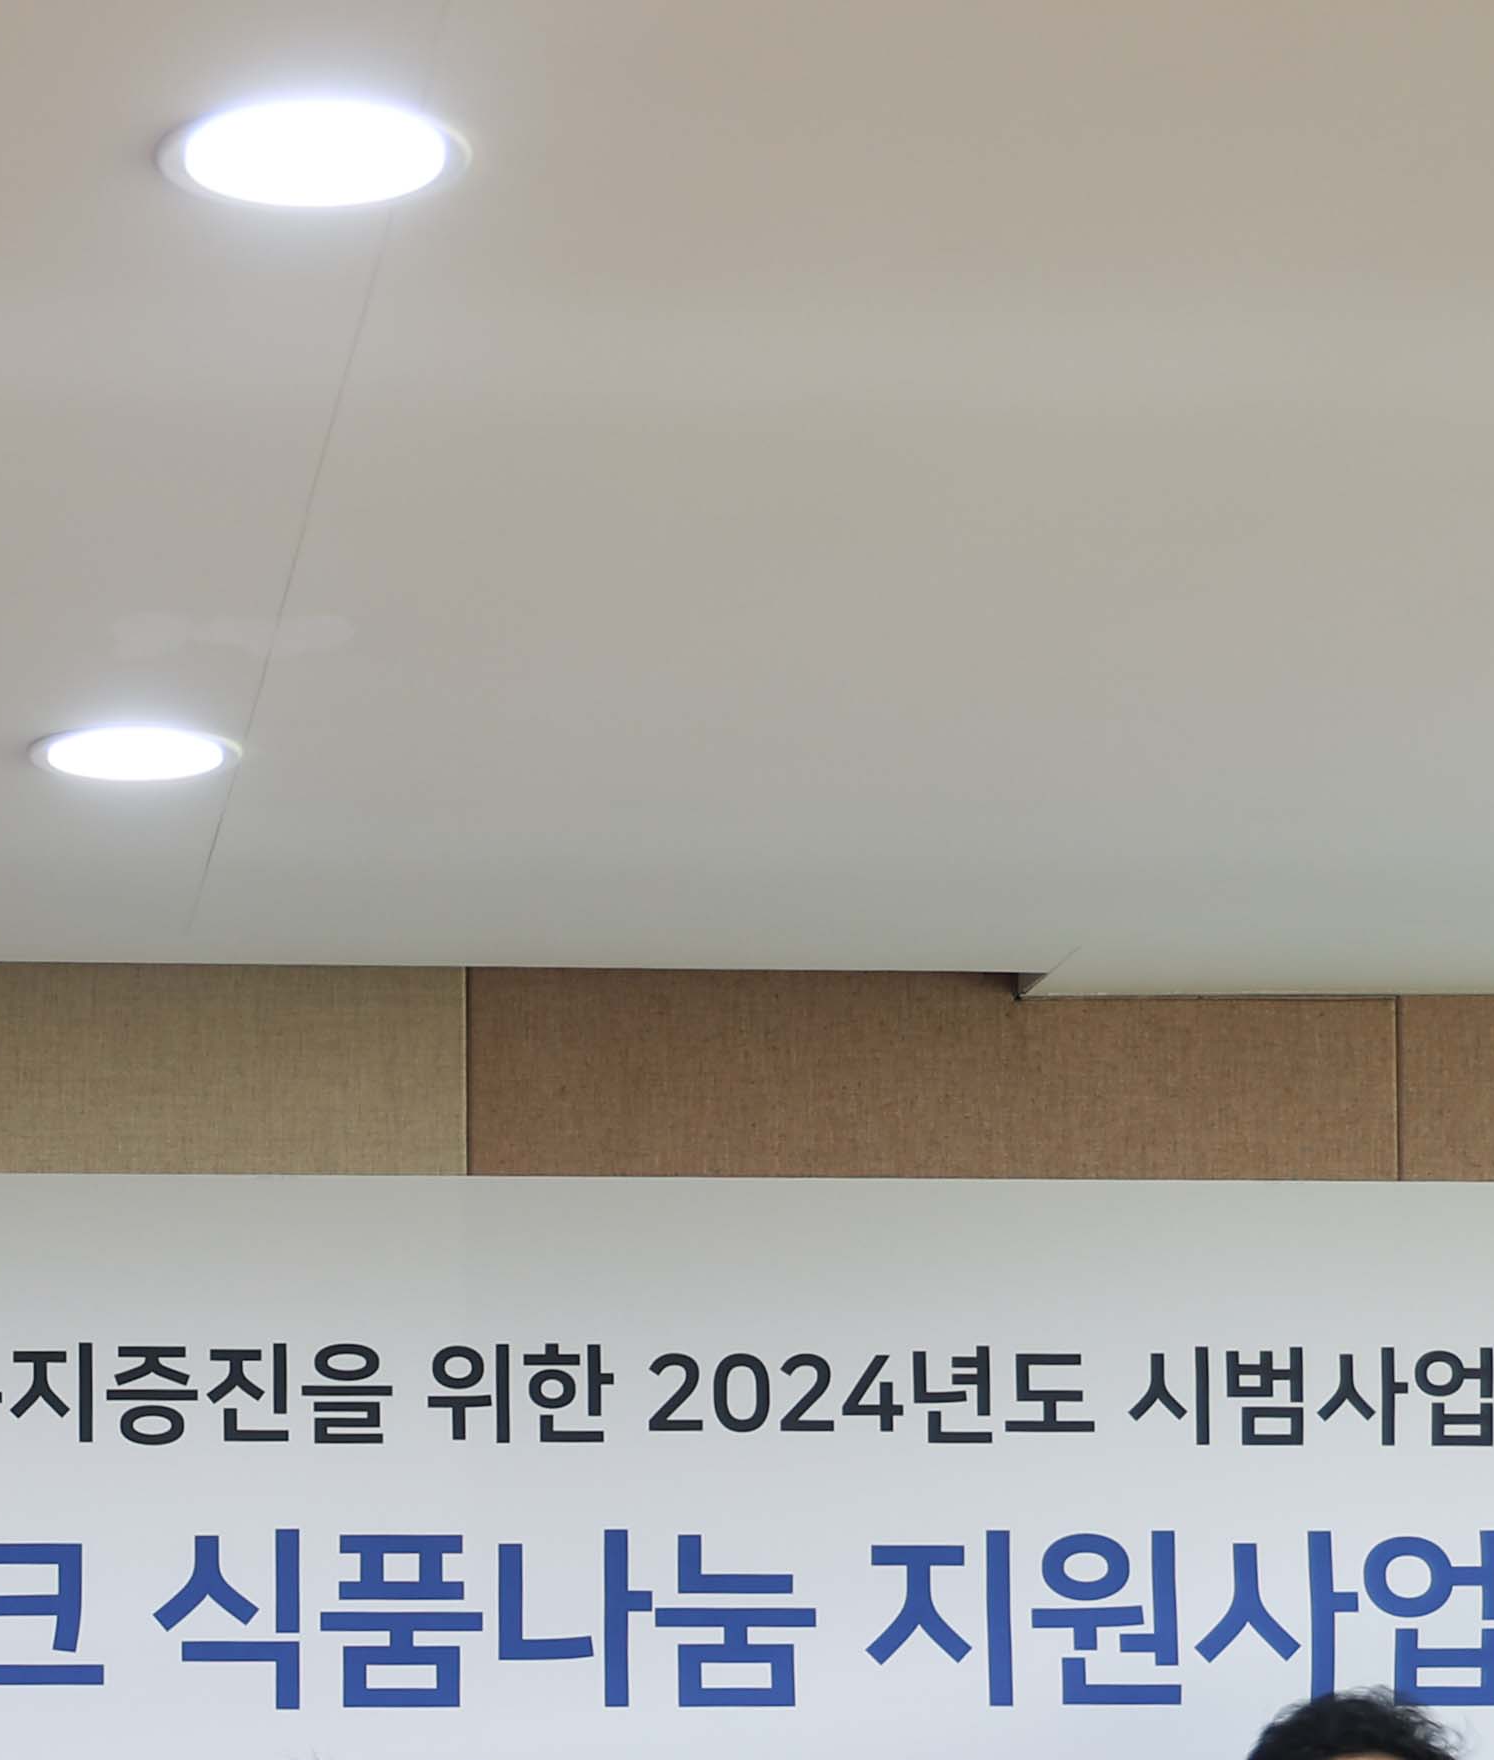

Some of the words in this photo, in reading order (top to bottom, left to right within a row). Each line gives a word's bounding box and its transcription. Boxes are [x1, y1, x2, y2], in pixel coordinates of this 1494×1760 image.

[427, 1343, 614, 1443] 위한
[649, 1345, 1095, 1443] 2024년도
[1128, 1346, 1493, 1447] 시범사업
[153, 1528, 817, 1710] 식품나눔
